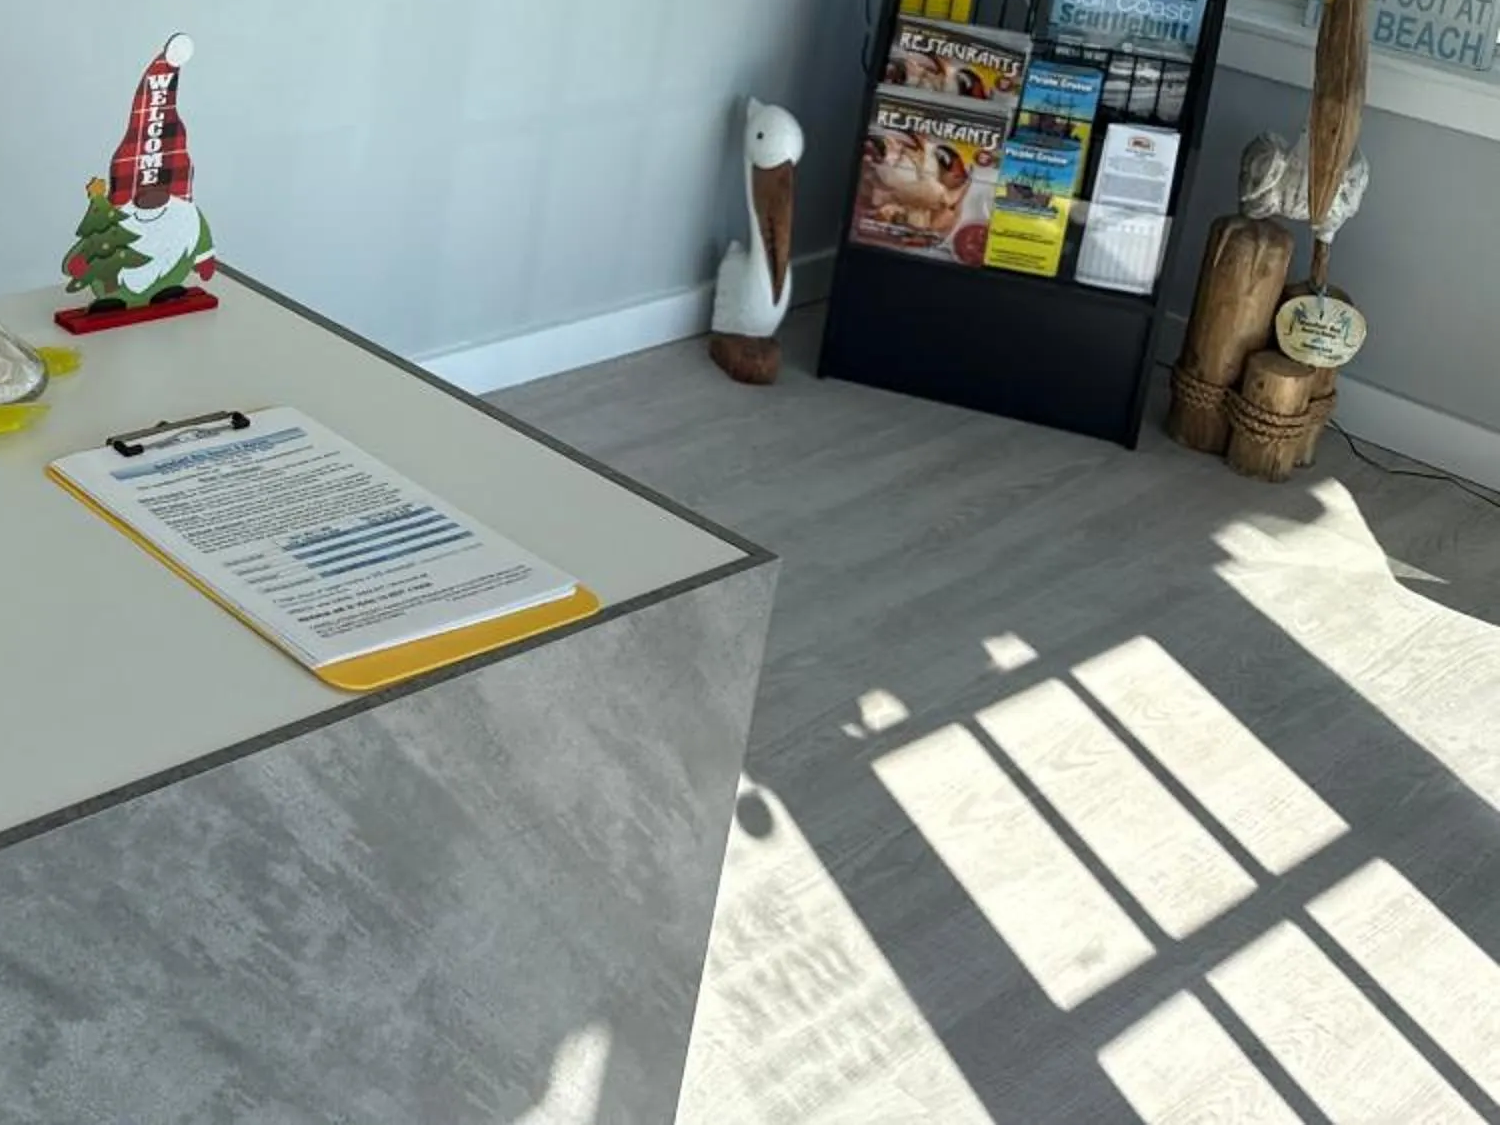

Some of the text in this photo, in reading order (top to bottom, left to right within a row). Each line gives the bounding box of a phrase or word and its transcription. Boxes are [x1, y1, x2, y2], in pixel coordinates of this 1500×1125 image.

[899, 31, 1022, 78] RESTAURANTS
[1373, 10, 1485, 66] BEACH
[138, 73, 174, 186] WELCOME
[876, 109, 1001, 151] RESTAURANTS
